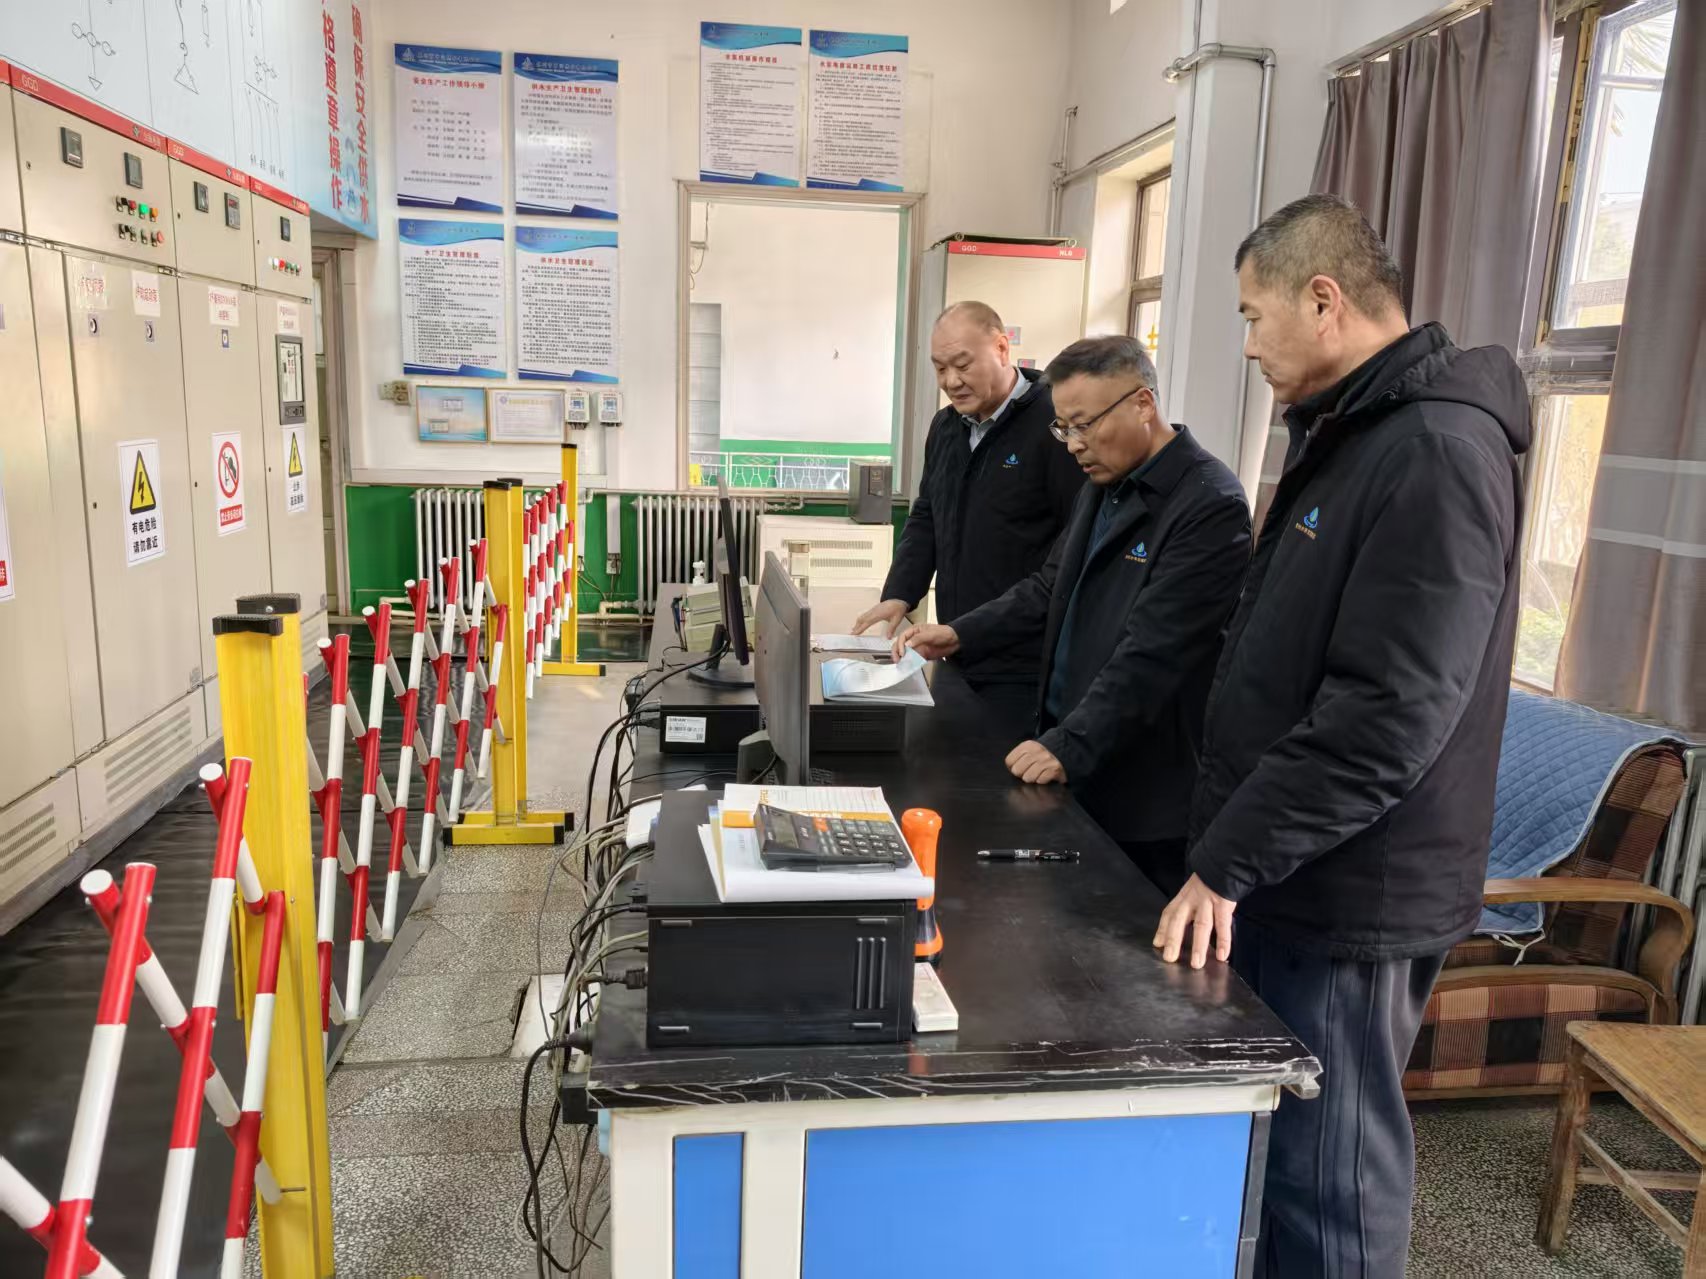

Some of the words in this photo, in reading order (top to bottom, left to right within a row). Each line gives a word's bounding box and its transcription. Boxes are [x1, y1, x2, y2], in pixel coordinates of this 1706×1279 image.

[21, 74, 39, 92] GGD
[413, 76, 485, 90] 安全生产工作领导小组
[321, 0, 342, 210] 格遵章操作
[351, 4, 369, 224] 确保安全供水
[132, 517, 157, 535] 有电危险
[133, 535, 158, 554] 请勿靠近
